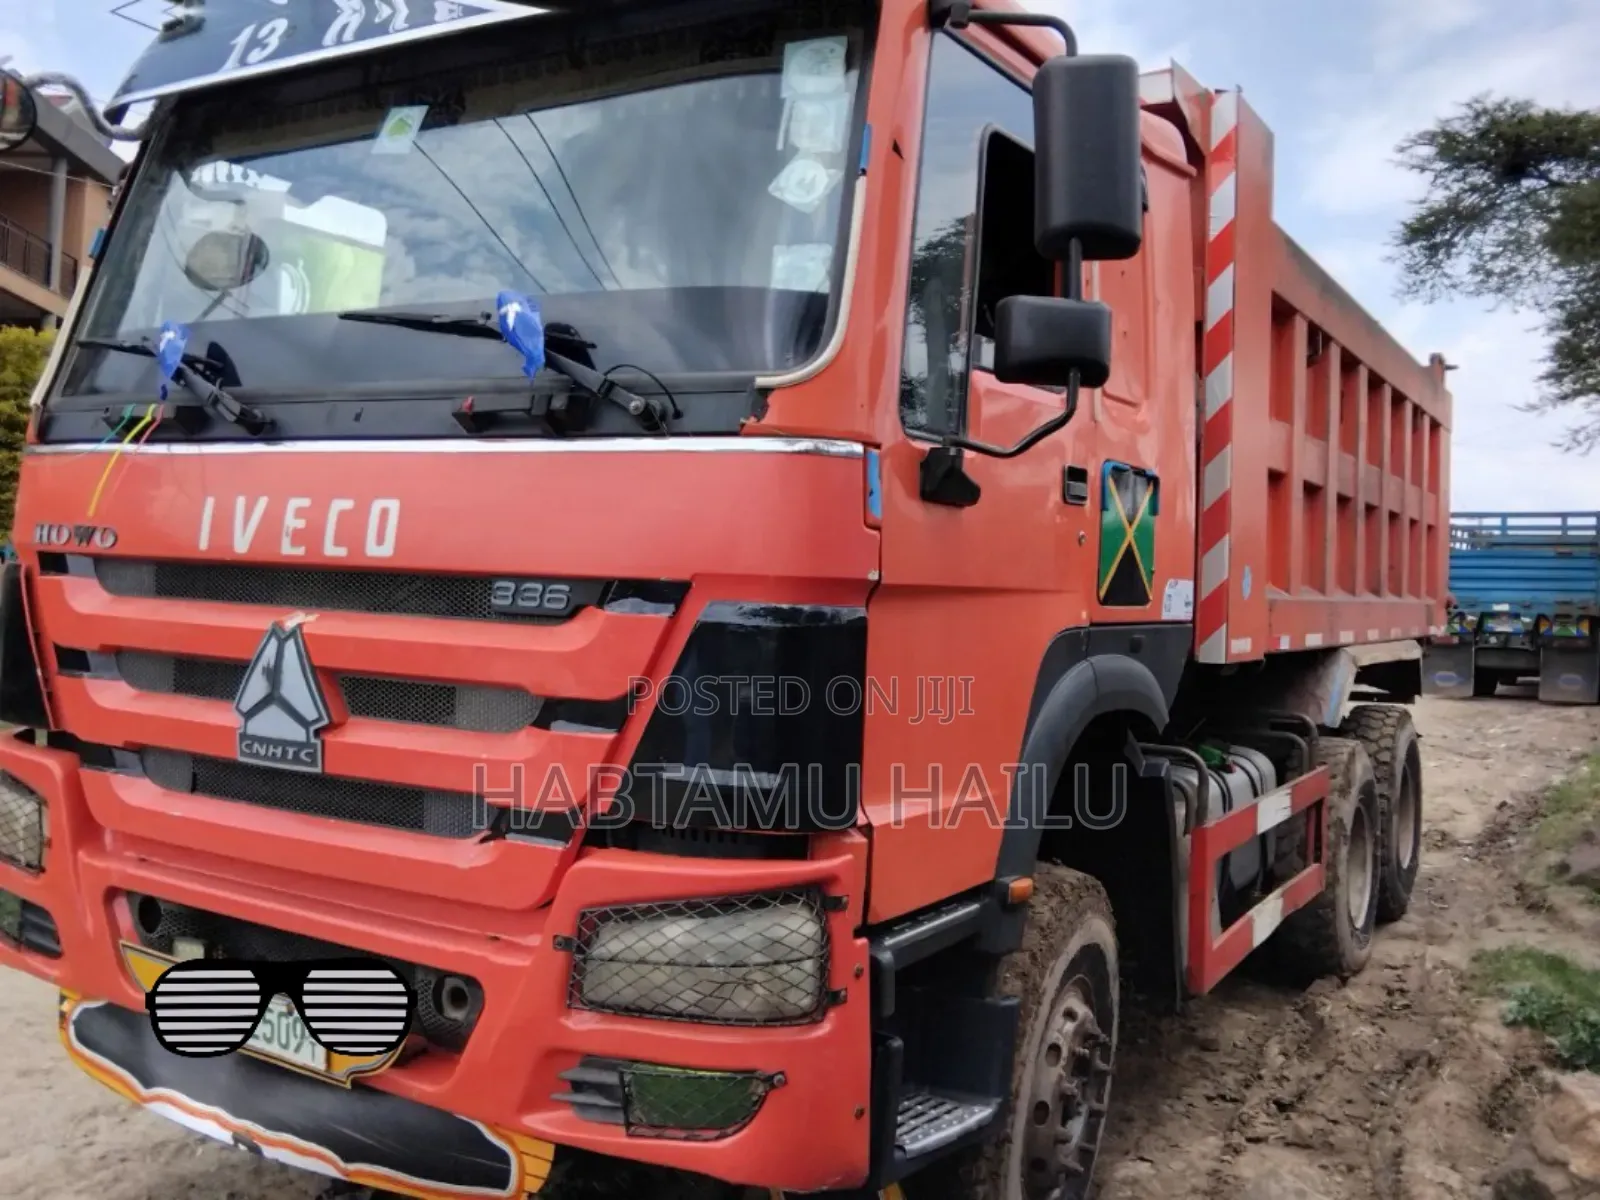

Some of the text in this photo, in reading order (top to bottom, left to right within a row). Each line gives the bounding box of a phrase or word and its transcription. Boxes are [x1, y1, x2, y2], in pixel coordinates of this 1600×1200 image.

[35, 523, 118, 549] HOWO
[199, 495, 401, 557] IVECO
[491, 581, 571, 610] 336
[241, 740, 315, 763] CNHTC
